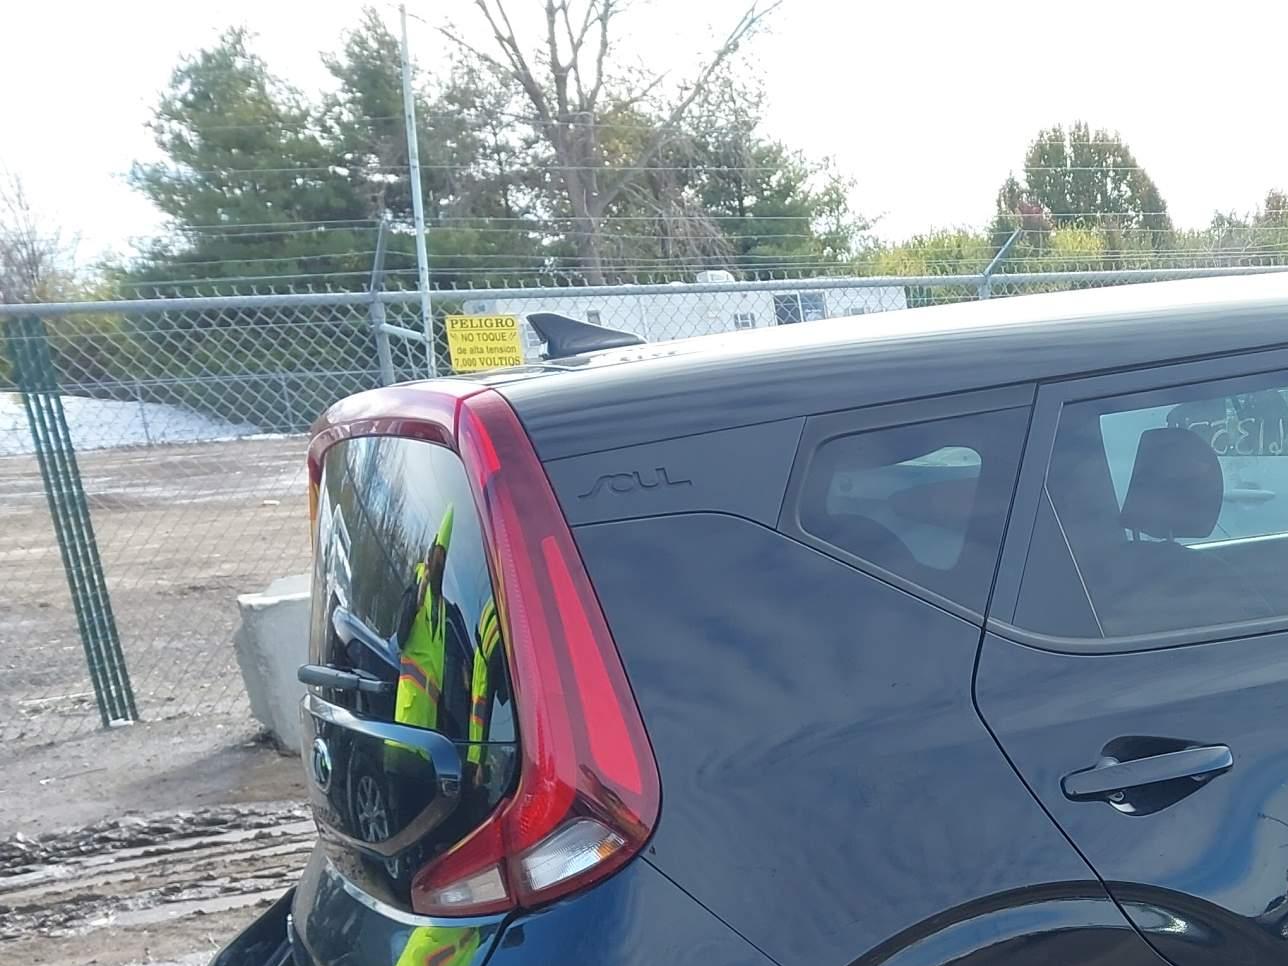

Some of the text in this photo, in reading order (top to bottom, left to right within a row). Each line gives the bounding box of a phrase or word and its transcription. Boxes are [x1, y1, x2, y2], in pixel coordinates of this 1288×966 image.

[450, 318, 515, 329] PELIGRO
[461, 331, 507, 342] NO TOQUE
[456, 346, 467, 355] de
[469, 346, 485, 354] alta
[478, 356, 521, 367] VOLTIOS
[577, 466, 693, 500] SOUL
